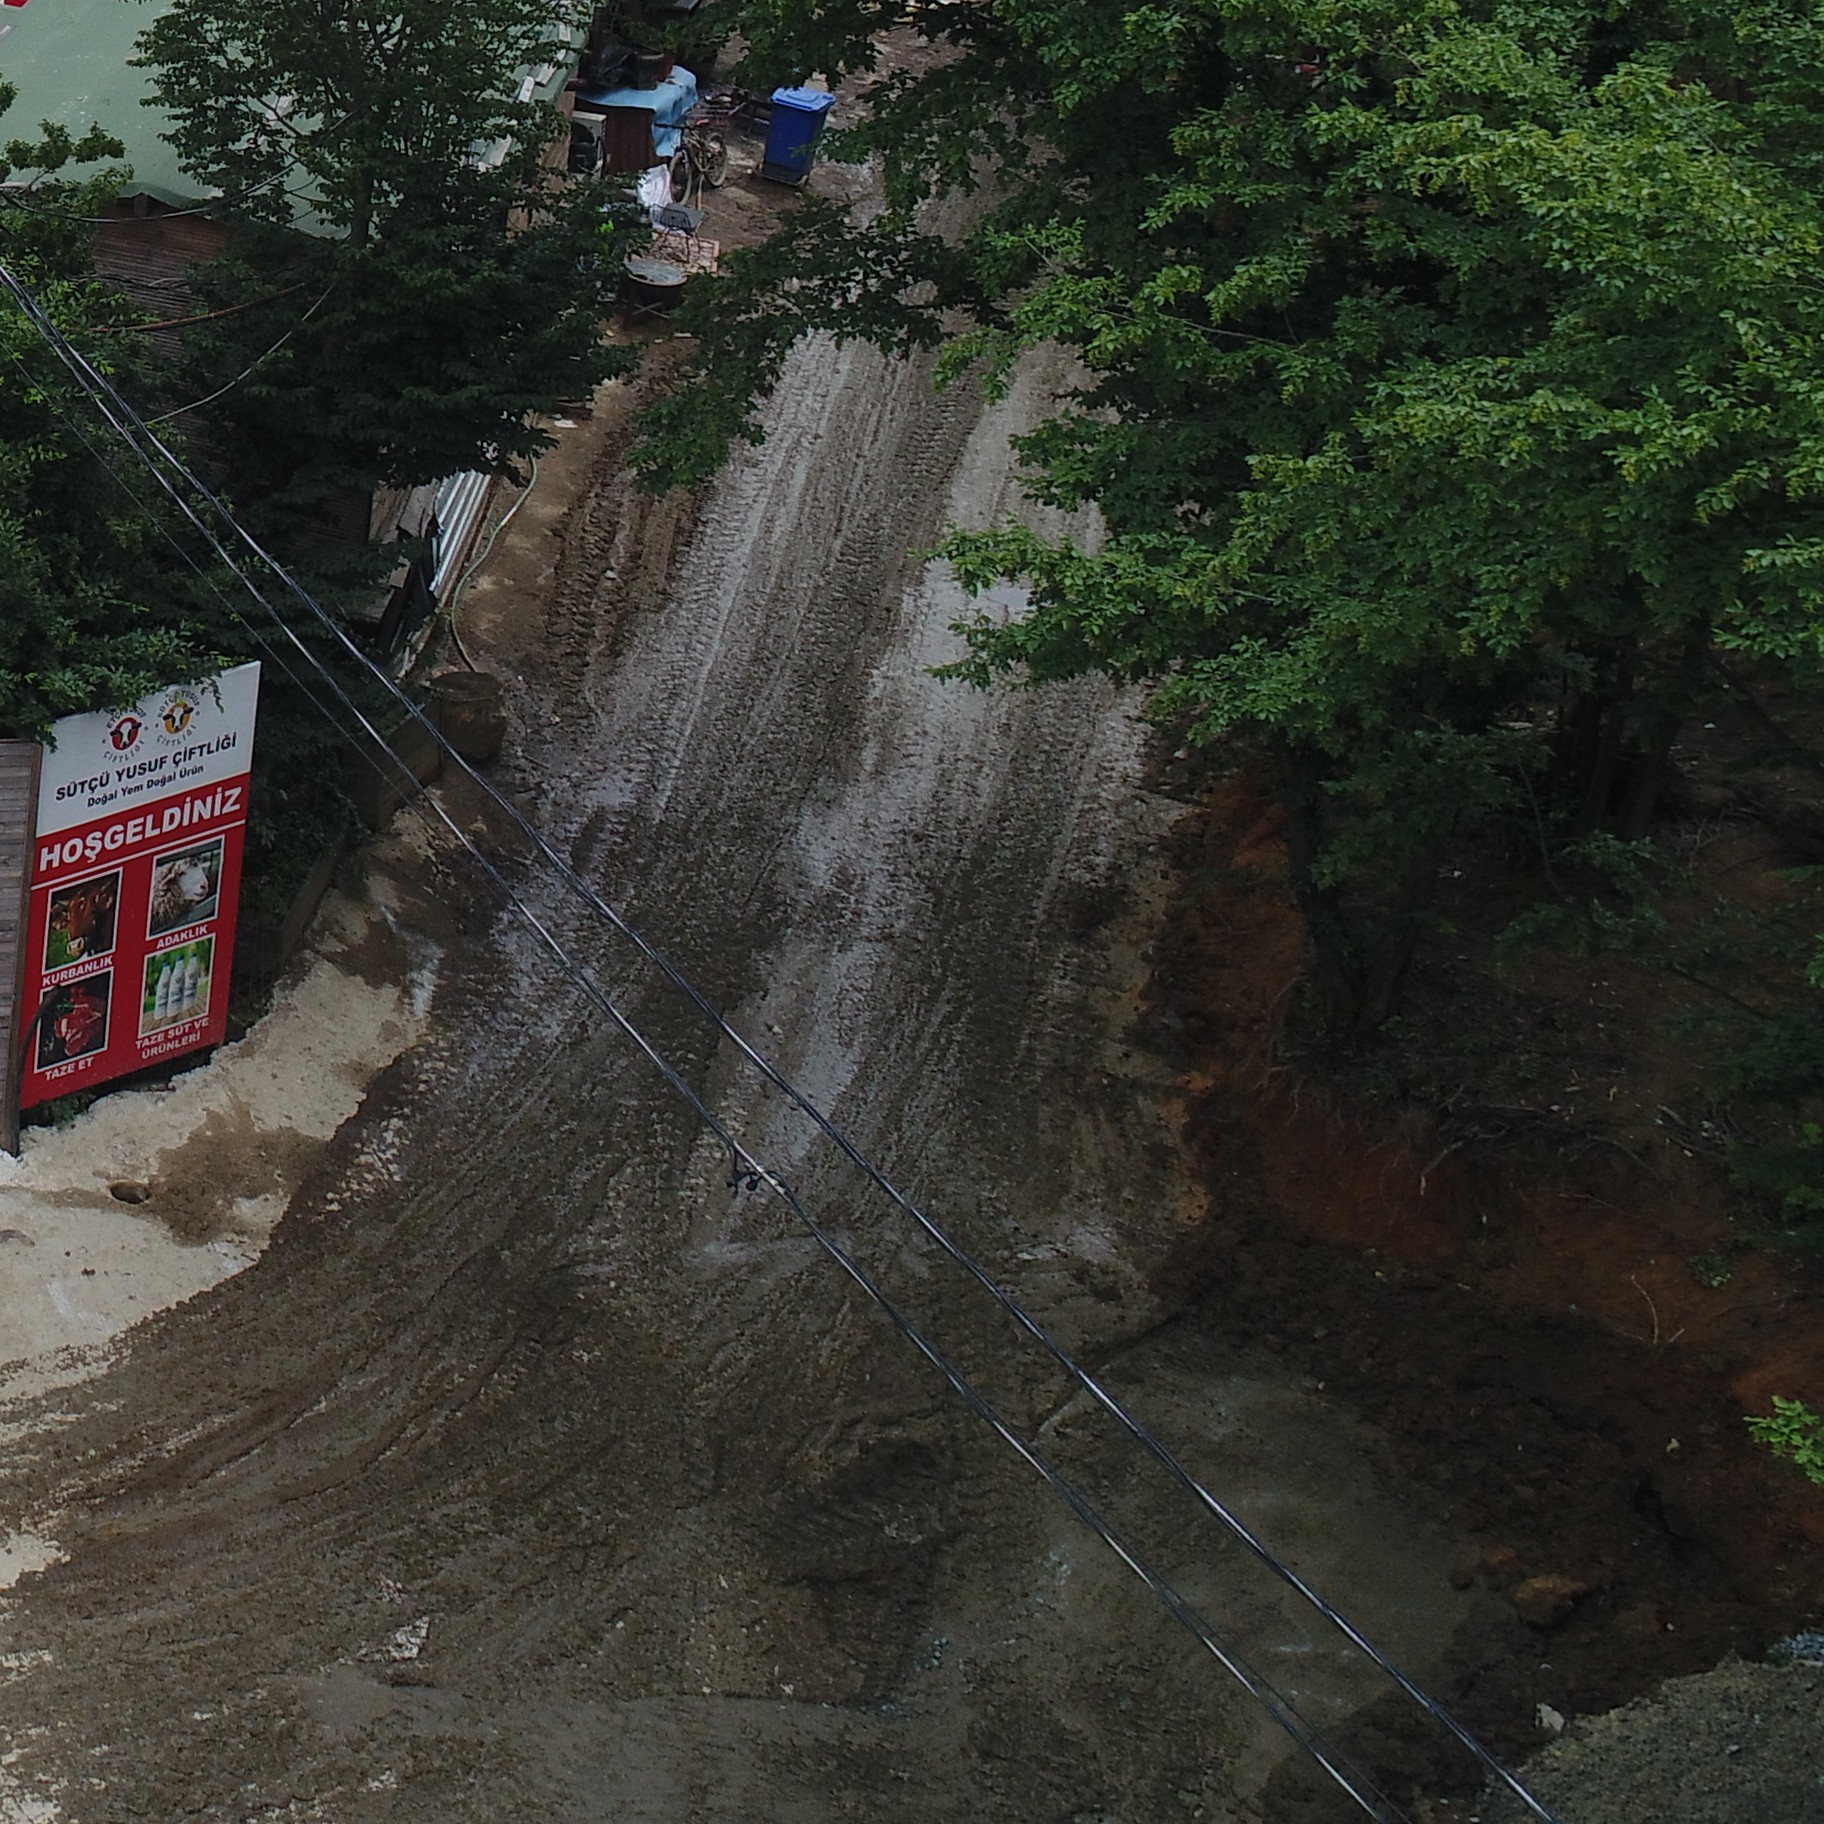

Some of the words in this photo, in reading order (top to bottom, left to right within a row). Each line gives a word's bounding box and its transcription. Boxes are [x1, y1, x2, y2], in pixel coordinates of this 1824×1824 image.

[55, 769, 110, 801] SÜTÇÜ
[115, 755, 168, 783] YUSUF
[172, 731, 237, 768] ÇİFTLİĞİ
[87, 789, 118, 808] Doğal
[121, 784, 144, 797] Yem
[146, 774, 176, 790] Doğal
[179, 764, 204, 780] Ürün
[39, 786, 242, 872] HOŞGELDİNİZ
[156, 924, 208, 950] ADAKLIK
[42, 955, 113, 987] KURBANLIK
[135, 1033, 165, 1050] TAZE
[168, 1023, 192, 1039] SÜT
[194, 1017, 210, 1032] VE
[141, 1030, 201, 1060] ÜRÜNLERİ
[44, 1063, 75, 1081] TAZE
[78, 1057, 95, 1070] ET
